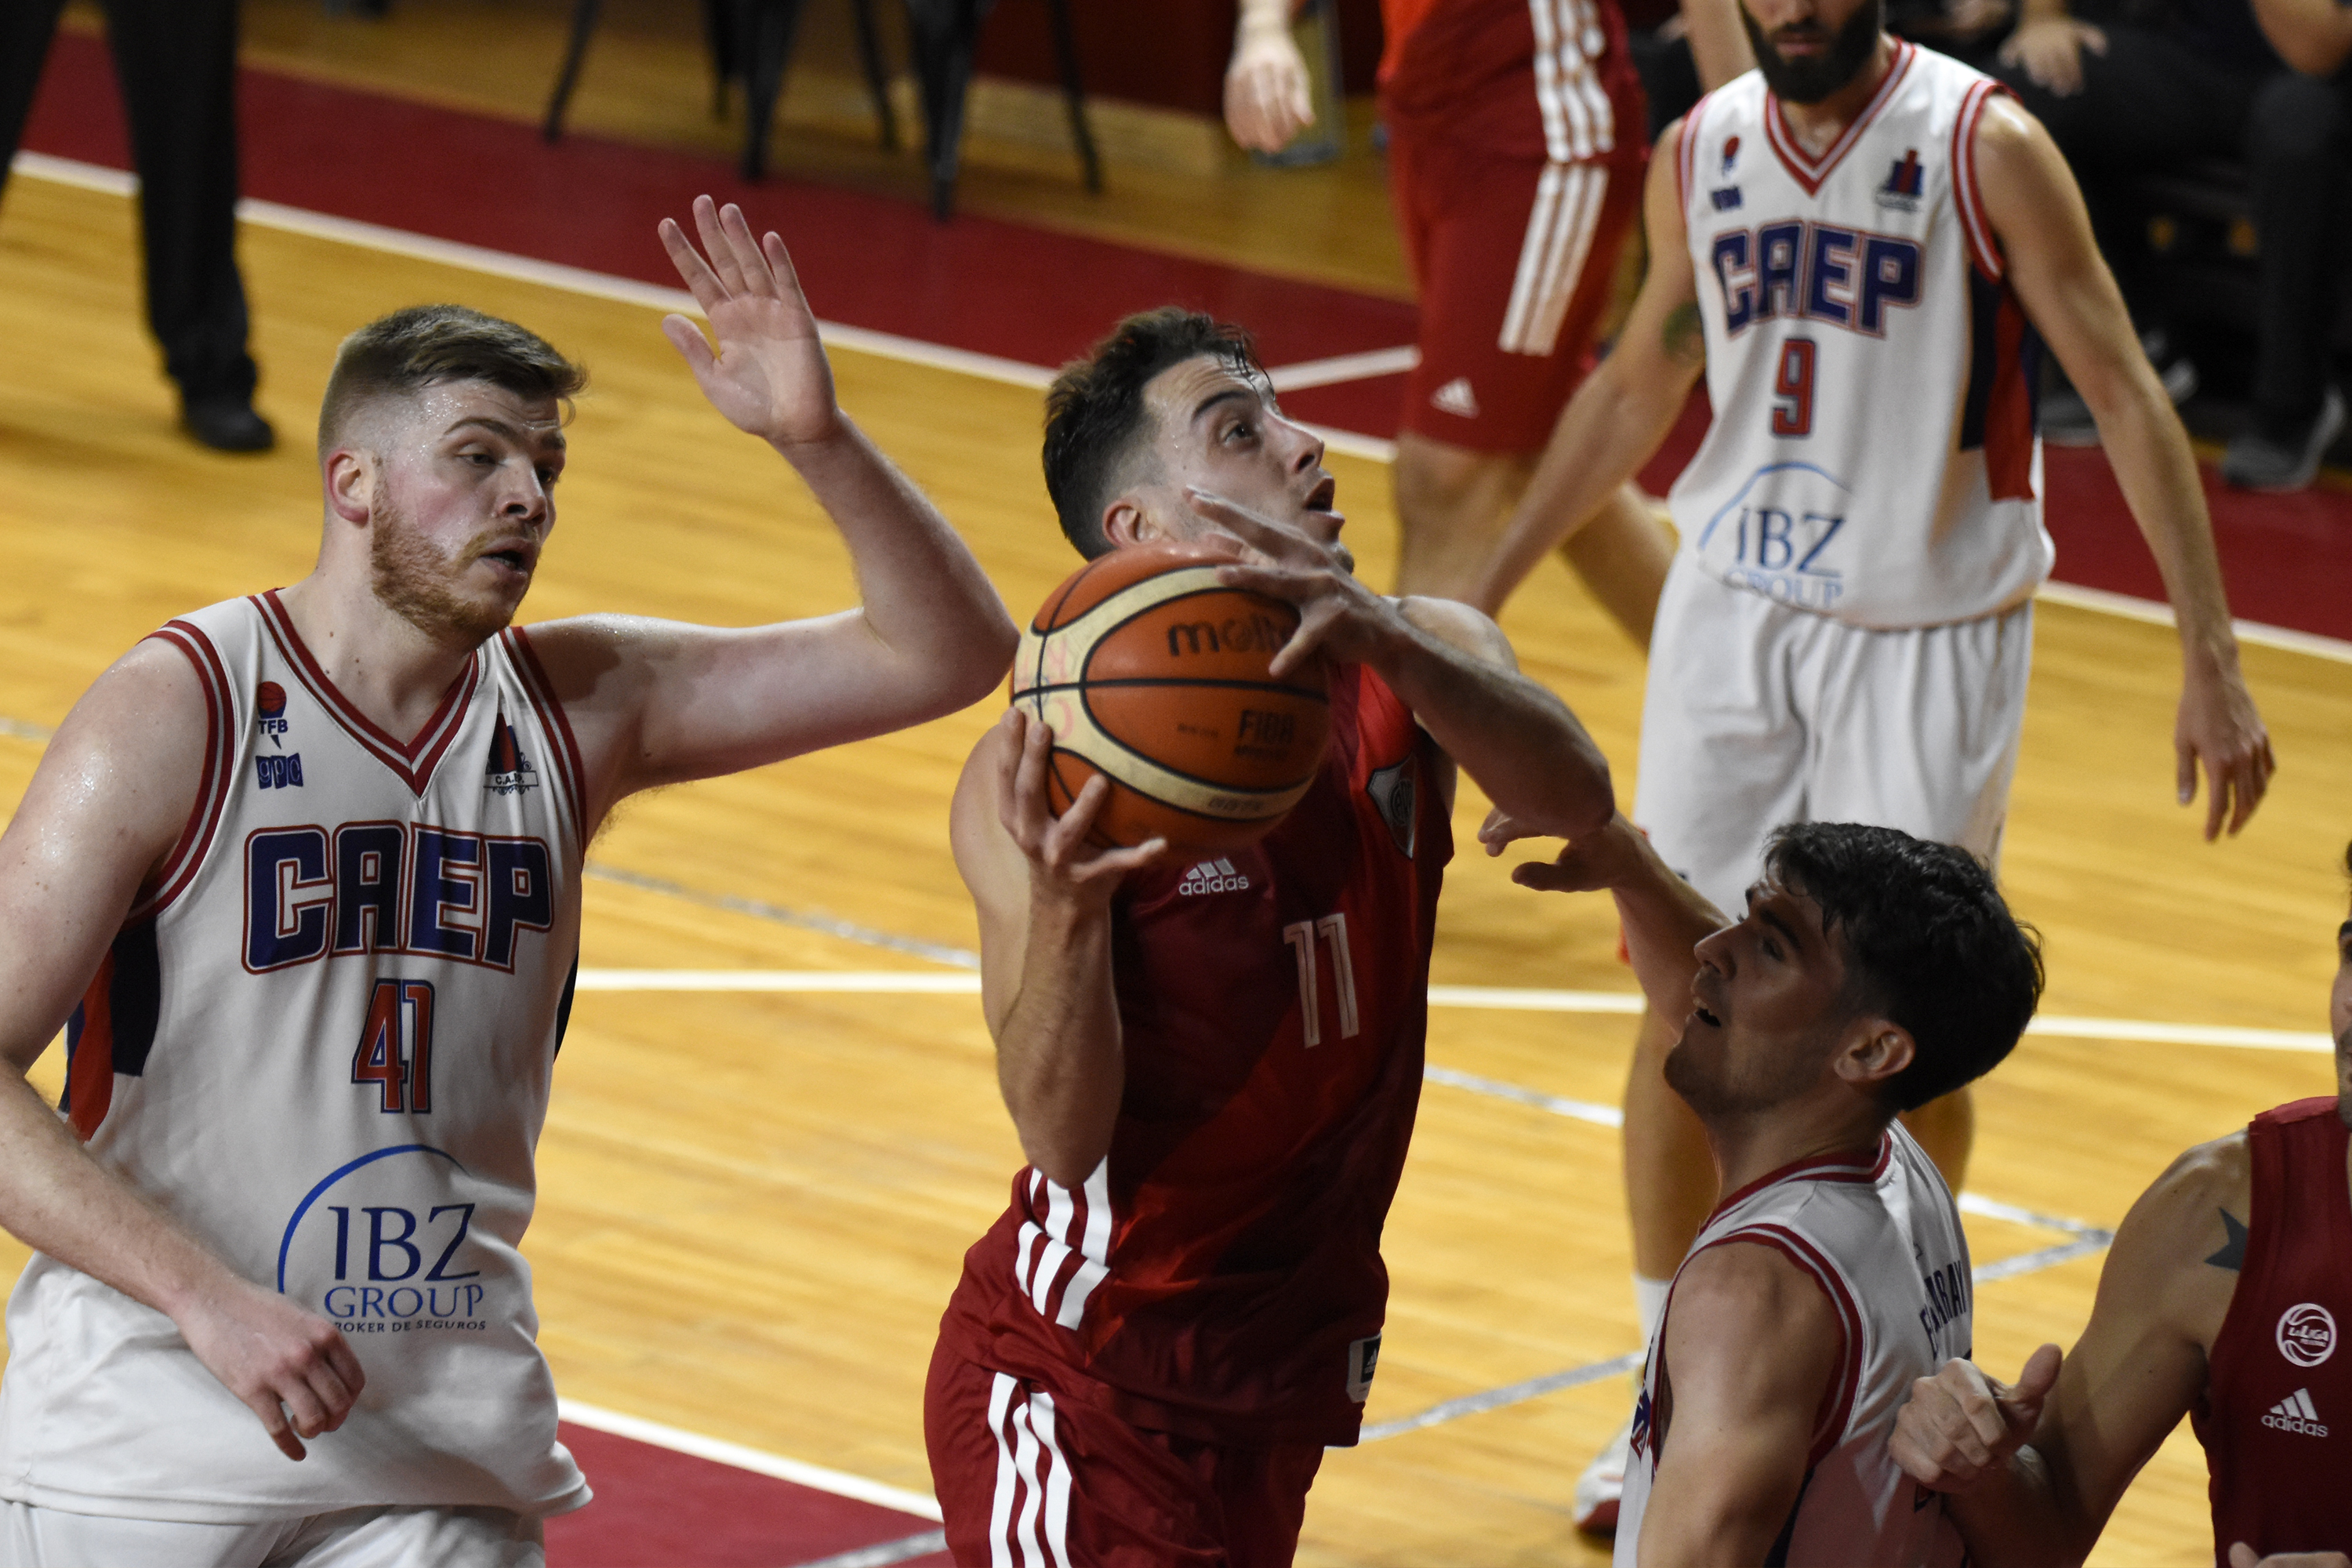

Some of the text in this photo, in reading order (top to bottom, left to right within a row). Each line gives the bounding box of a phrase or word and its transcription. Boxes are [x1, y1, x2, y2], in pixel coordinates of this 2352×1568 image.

[1711, 220, 1925, 341] CAEP
[1771, 338, 1816, 438] 9
[1737, 506, 1846, 578] IBZ
[258, 719, 288, 734] TFB
[241, 819, 554, 975] CAEP
[1179, 876, 1249, 895] adidas
[1283, 913, 1359, 1049] 11
[351, 978, 435, 1113] 41
[328, 1203, 480, 1281] IBZ
[325, 1284, 483, 1318] GROUP
[336, 1319, 486, 1333] ROKER DE SEGUROS
[2261, 1414, 2328, 1437] adidas
